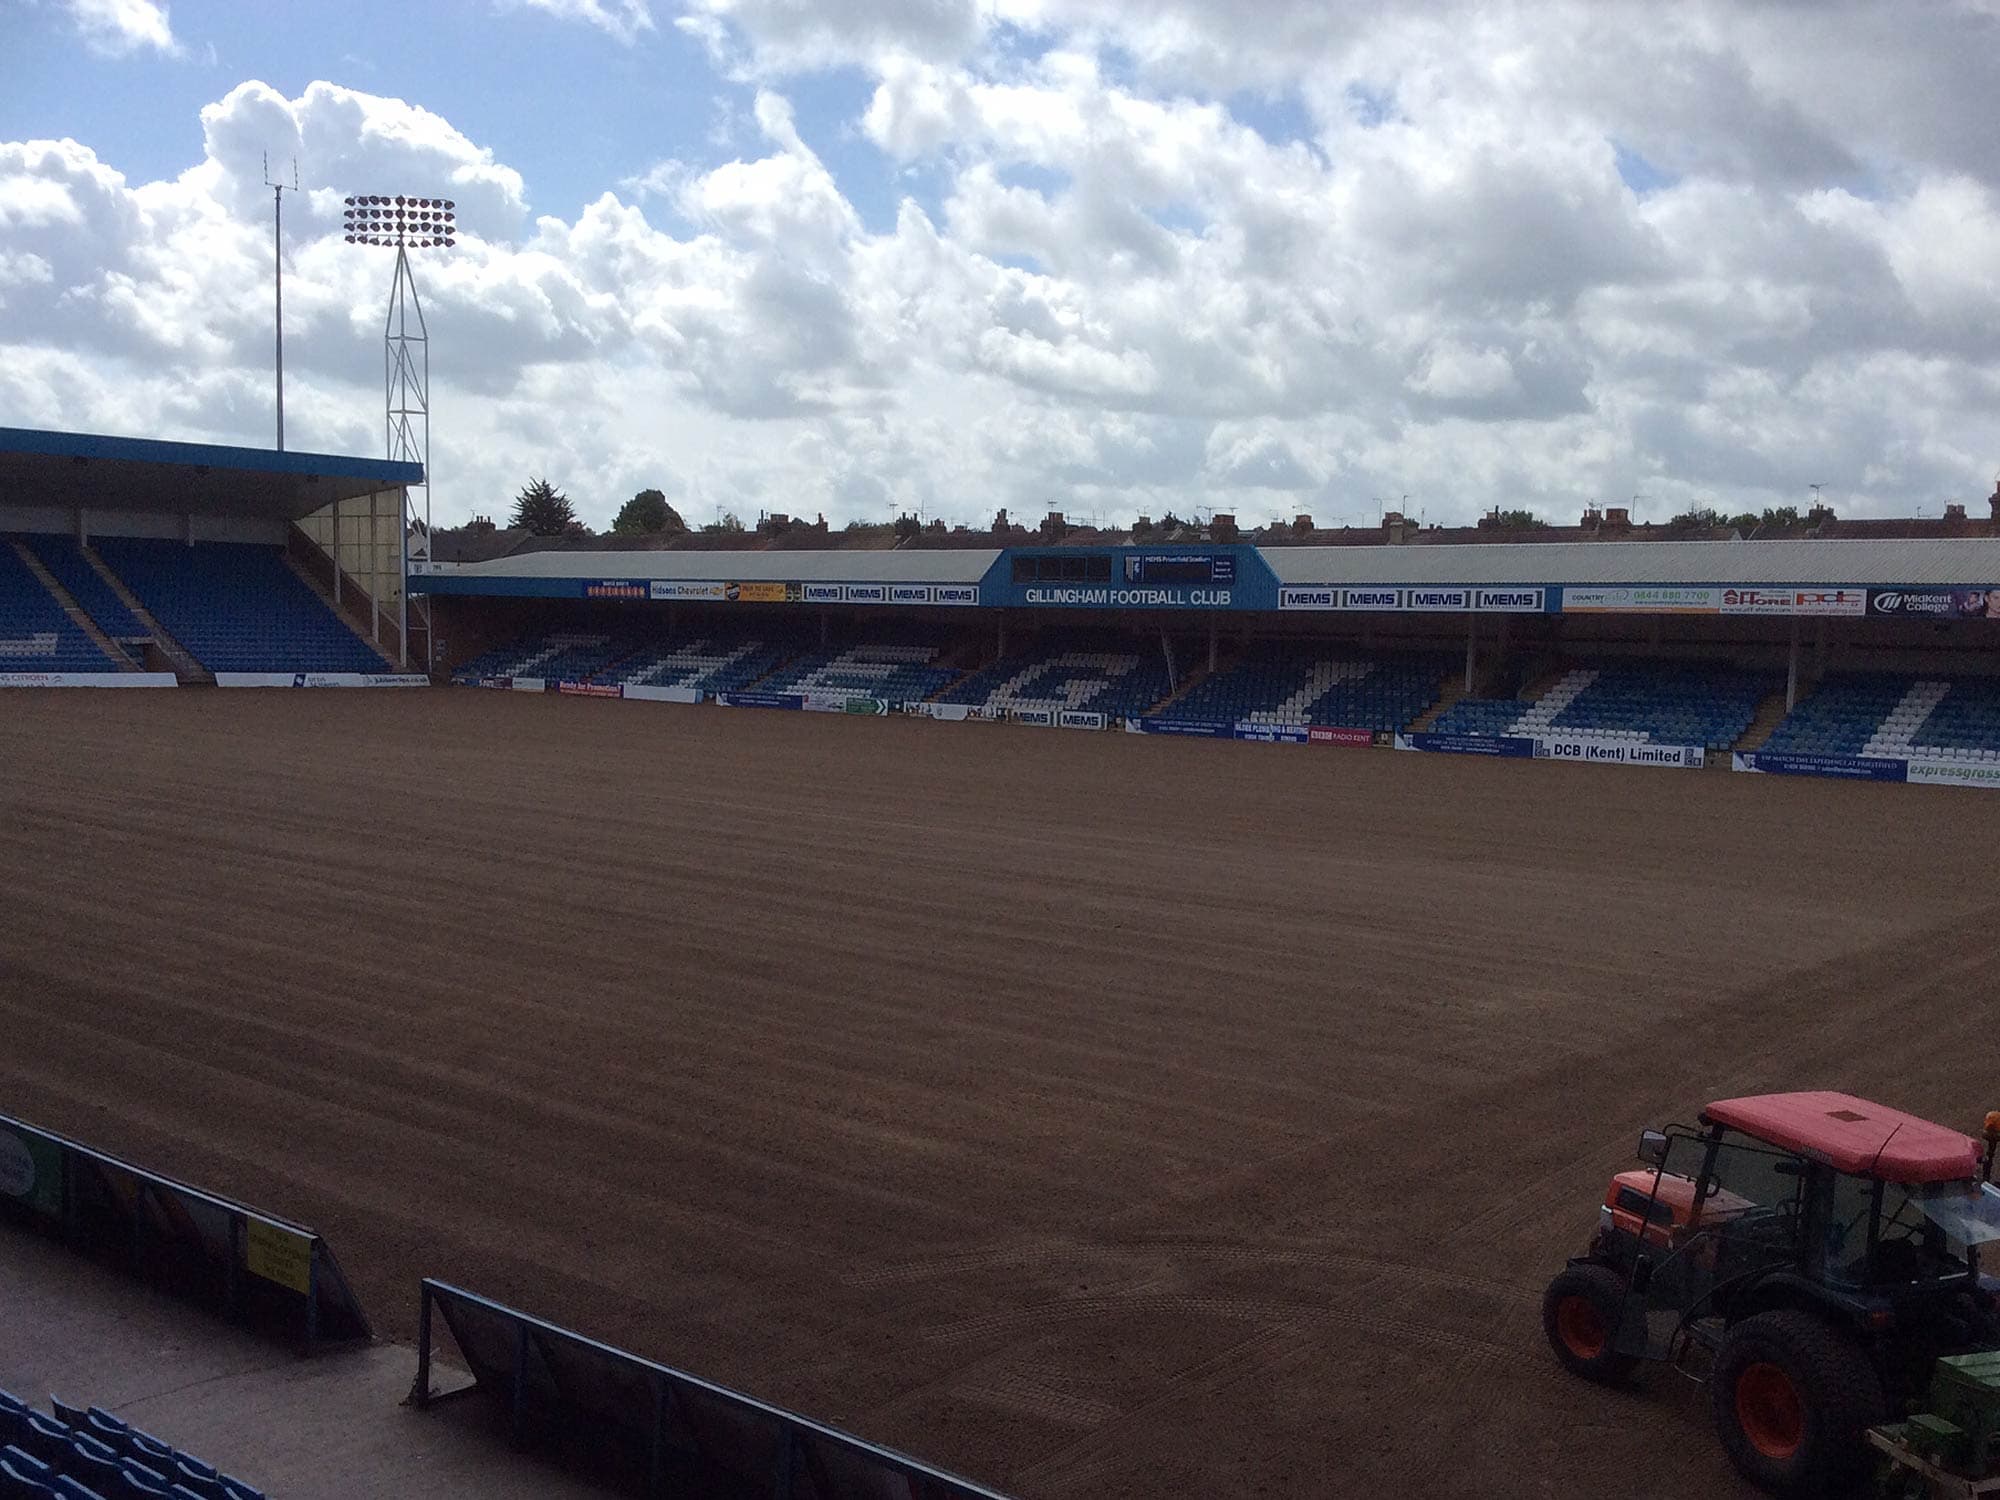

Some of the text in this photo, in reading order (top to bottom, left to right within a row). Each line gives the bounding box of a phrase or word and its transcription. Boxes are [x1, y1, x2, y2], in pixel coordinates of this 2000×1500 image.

[677, 586, 709, 596] Chevrolet
[808, 588, 838, 599] MEMS
[851, 589, 882, 599] MEMS
[893, 589, 926, 600] MEMS
[939, 590, 972, 601] MEMS
[1633, 591, 1659, 600] 0844
[1684, 592, 1710, 600] 7700
[1025, 588, 1231, 606] GILLINGHAM FOOTBALL CLUB
[1287, 593, 1331, 605] MEMS
[1350, 593, 1395, 605] MEMS
[1415, 594, 1463, 606] MEMS
[1483, 594, 1533, 606] MEMS
[1903, 594, 1953, 604] MidKent
[1906, 602, 1949, 613] College
[1012, 712, 1049, 724] MEMS
[1062, 714, 1100, 727] MEMS
[1554, 743, 1581, 756] DCB
[1585, 745, 1625, 762] (Kent)
[1630, 748, 1681, 763] Limited
